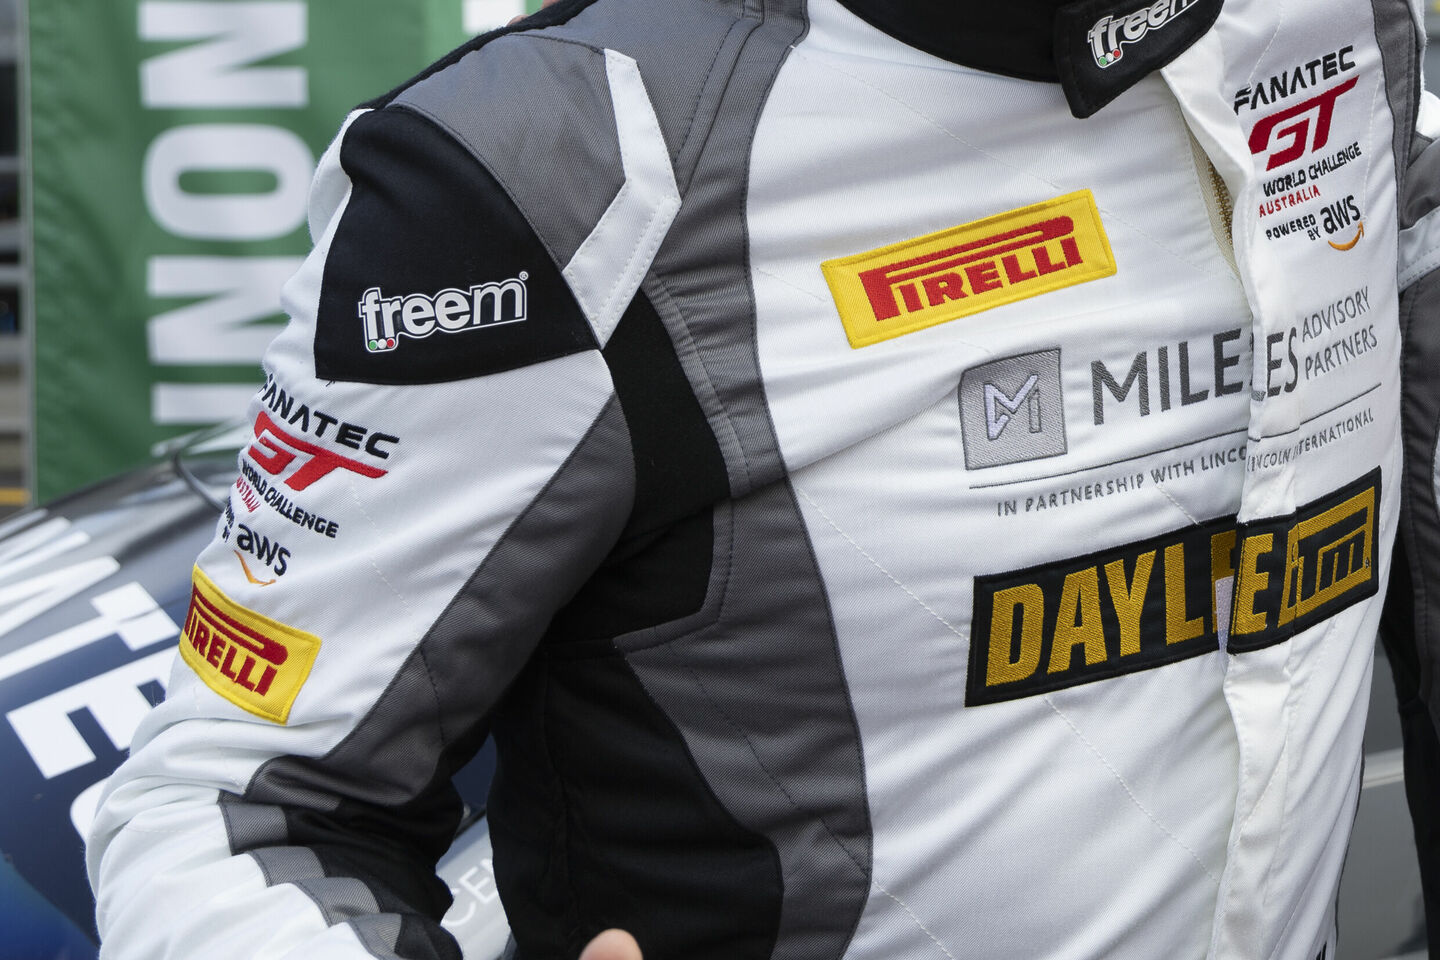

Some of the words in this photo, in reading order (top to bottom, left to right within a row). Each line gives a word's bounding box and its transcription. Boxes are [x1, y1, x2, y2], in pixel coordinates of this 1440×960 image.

[1233, 45, 1356, 116] FANATEC
[1248, 74, 1360, 172] GT
[1263, 169, 1306, 197] WORLD
[1308, 141, 1362, 181] CHALLENGE
[1259, 184, 1321, 218] AUSTRALIA
[1266, 213, 1317, 240] POWERED
[1320, 195, 1361, 235] aws
[1308, 225, 1321, 241] BY
[858, 214, 1083, 322] PIRELLI
[359, 279, 526, 348] freem
[1301, 286, 1372, 342] ADVISORY
[1304, 324, 1378, 380] PARTNERS
[248, 411, 388, 491] GT
[264, 486, 339, 538] CHALLENGE
[997, 500, 1017, 517] IN
[1025, 474, 1144, 513] PARTNERSHIP
[1151, 463, 1195, 484] WITH
[236, 523, 291, 576] aws
[184, 581, 289, 697] PIRELLI
